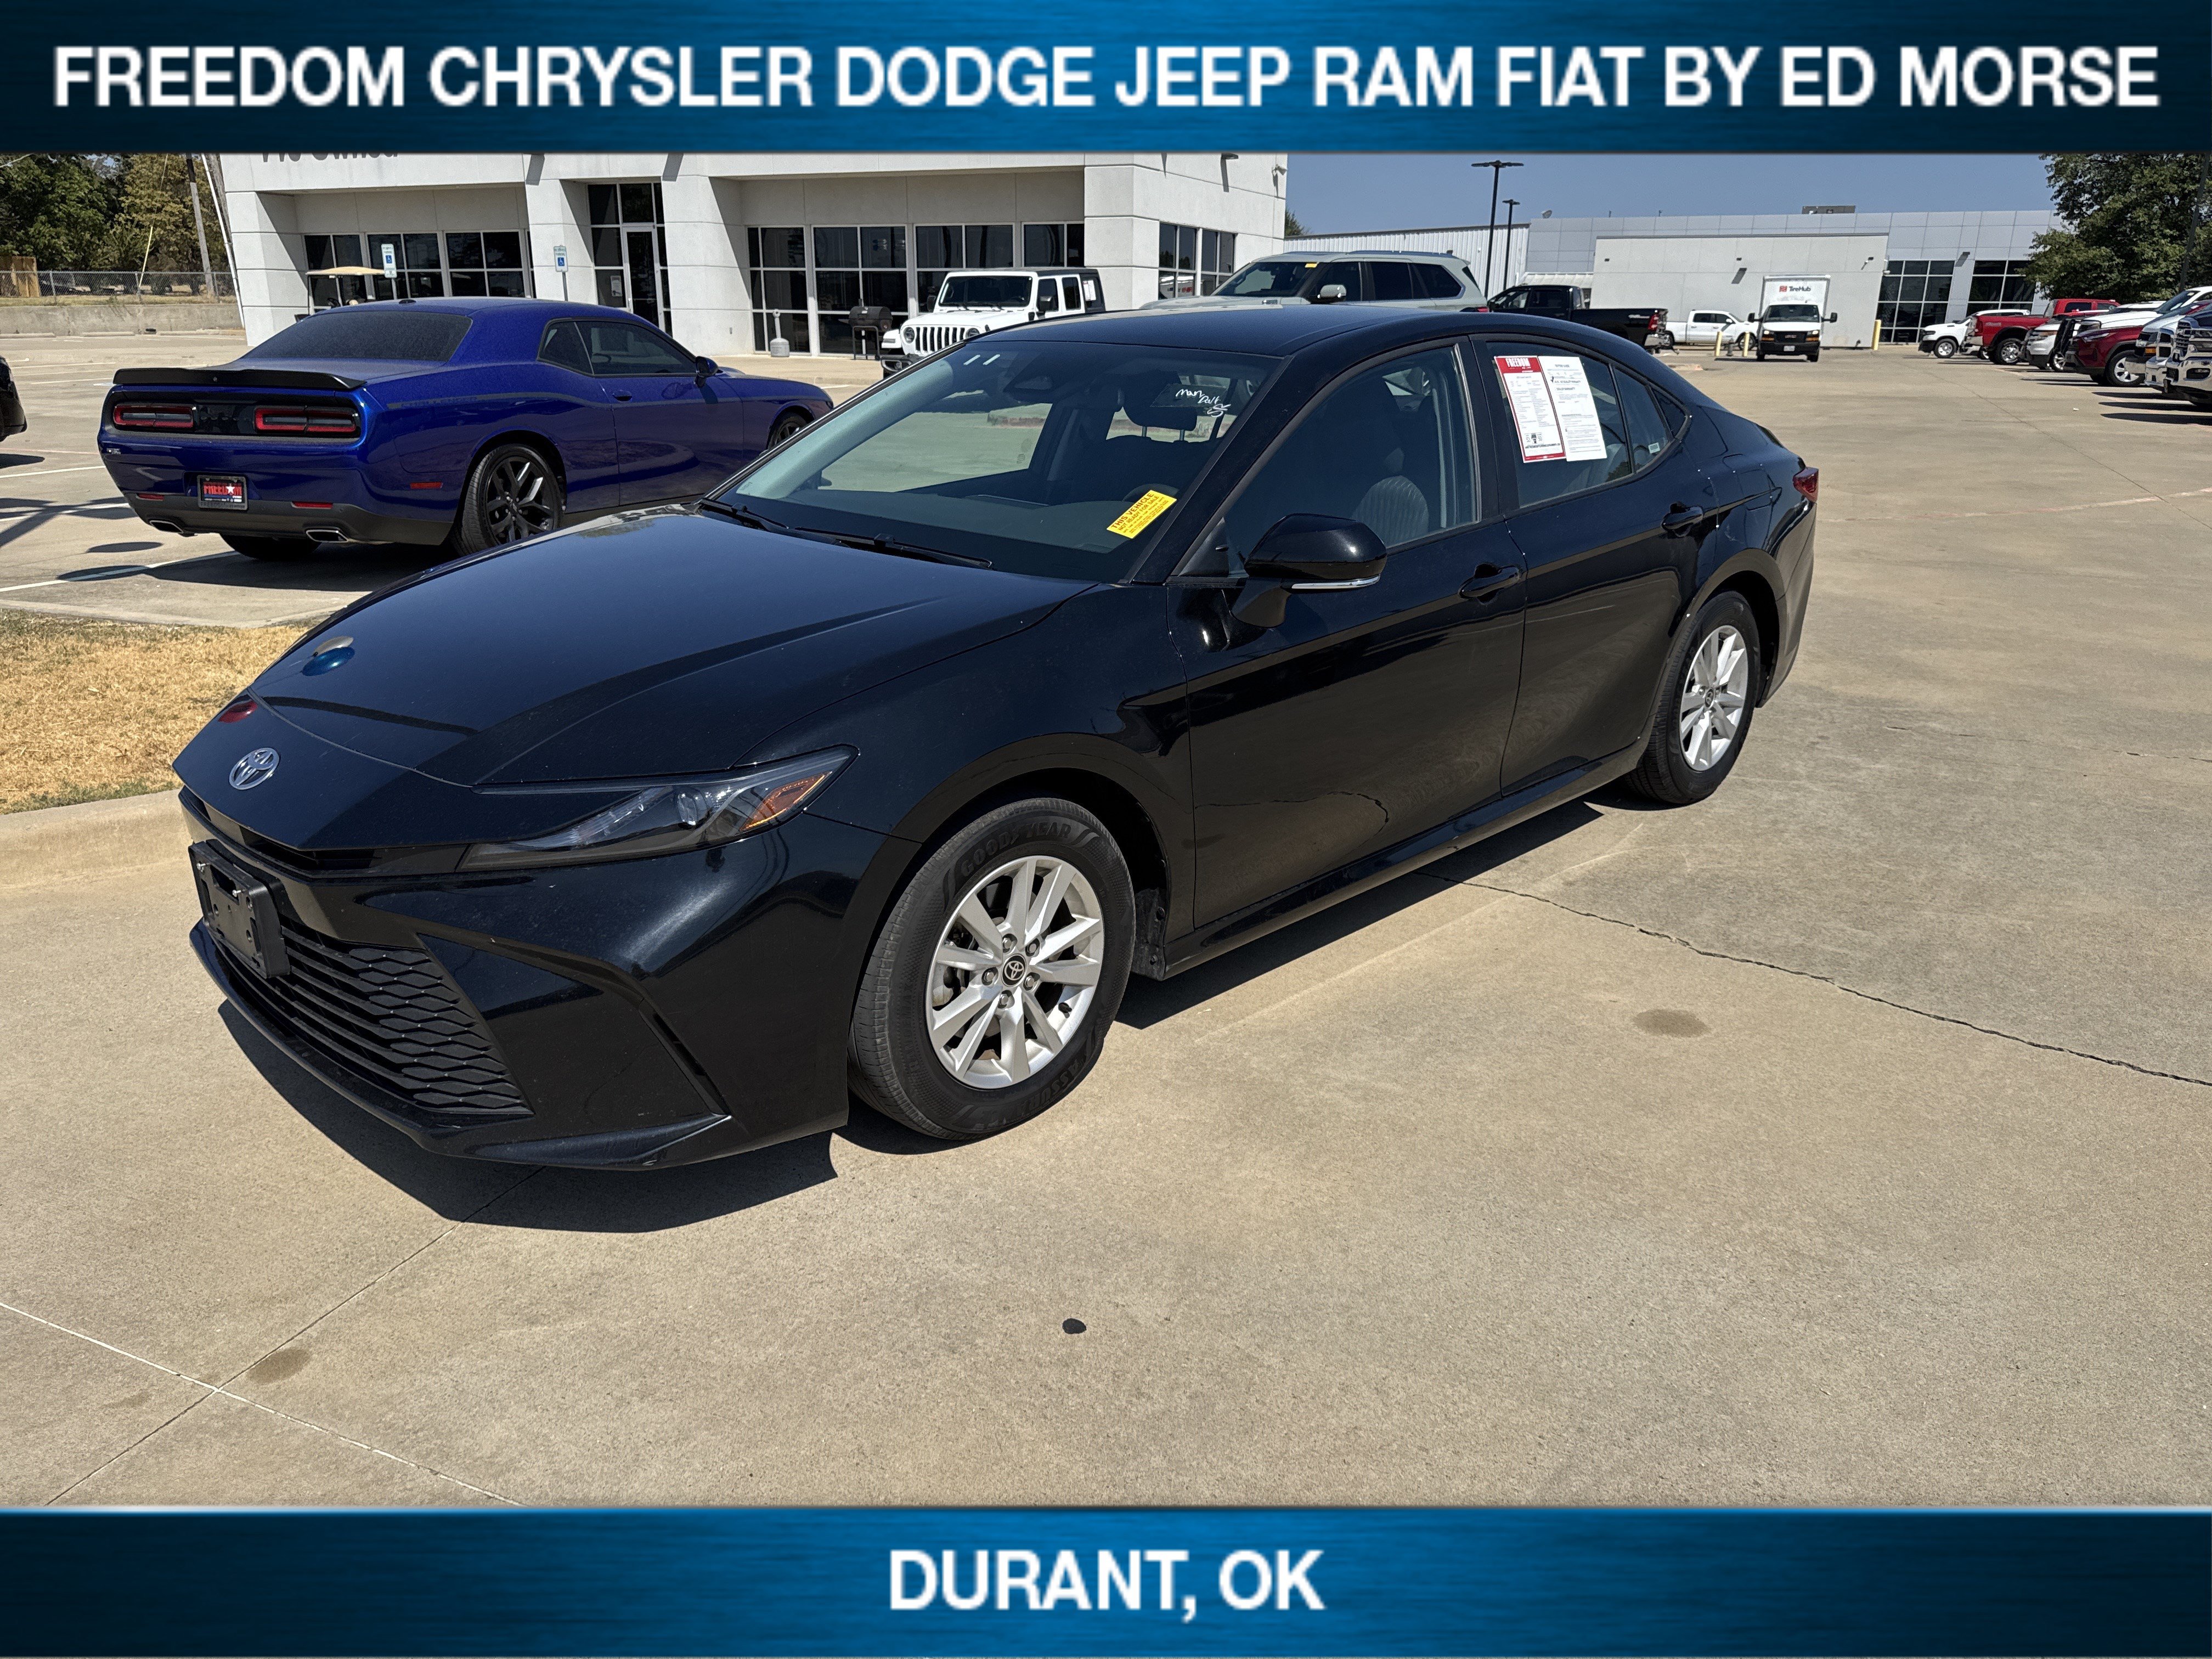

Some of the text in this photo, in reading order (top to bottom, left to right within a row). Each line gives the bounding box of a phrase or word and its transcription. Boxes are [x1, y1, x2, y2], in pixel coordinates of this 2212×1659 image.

[1111, 516, 1128, 528] THIS
[1126, 493, 1154, 515] VEHICLE
[1118, 522, 1128, 531] NOT
[1126, 511, 1141, 523] READY
[1148, 496, 1159, 505] SALE
